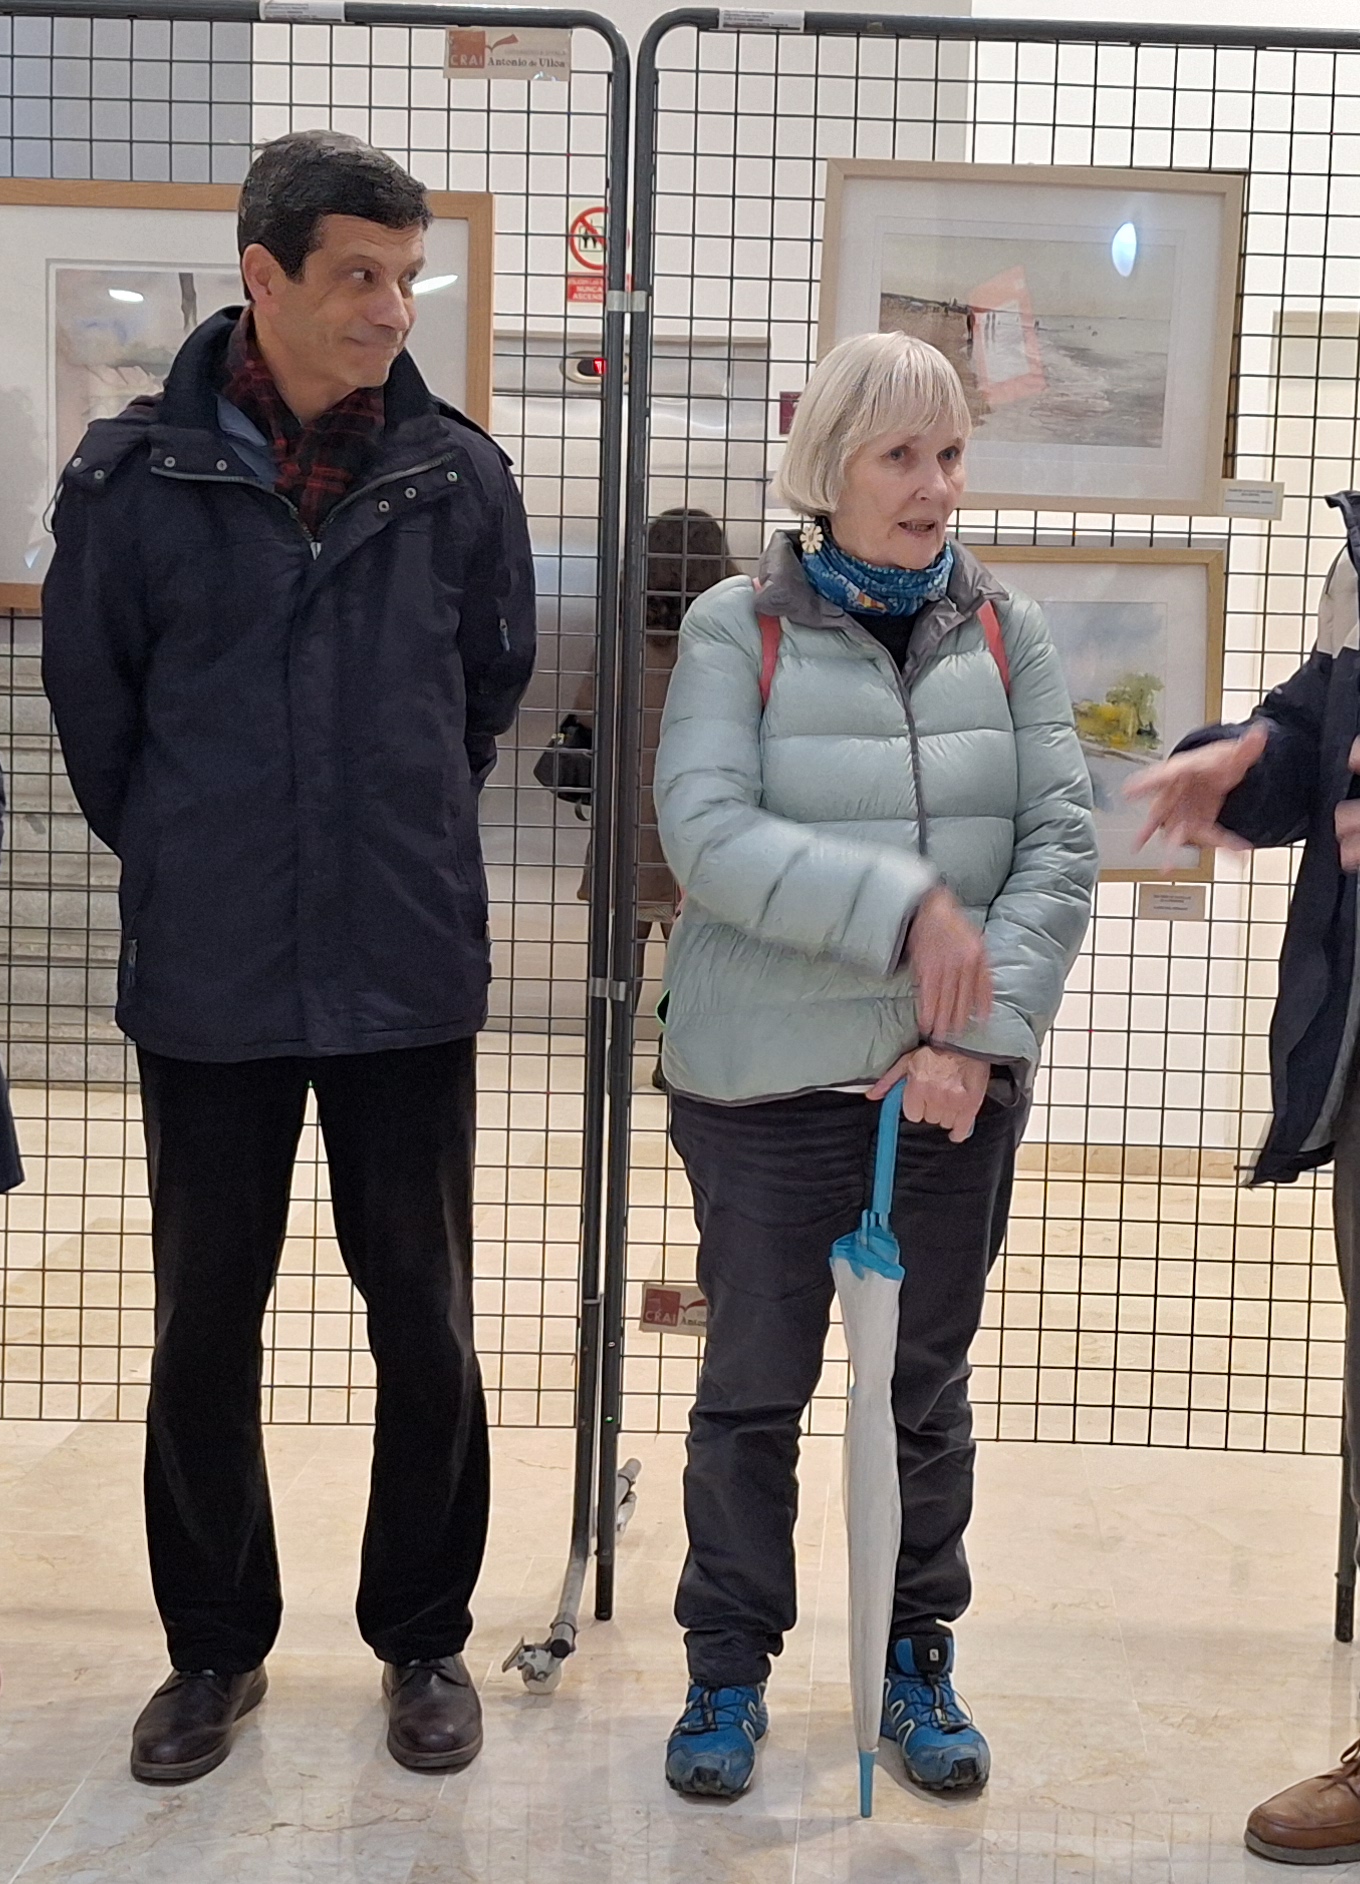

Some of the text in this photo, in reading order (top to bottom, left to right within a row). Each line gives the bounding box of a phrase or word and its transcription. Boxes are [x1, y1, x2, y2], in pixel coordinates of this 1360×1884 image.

[450, 54, 483, 66] CRAI
[487, 56, 527, 67] Antonio
[539, 57, 566, 68] Ulloa
[572, 292, 604, 300] ASCENS
[645, 1310, 677, 1325] CRAI
